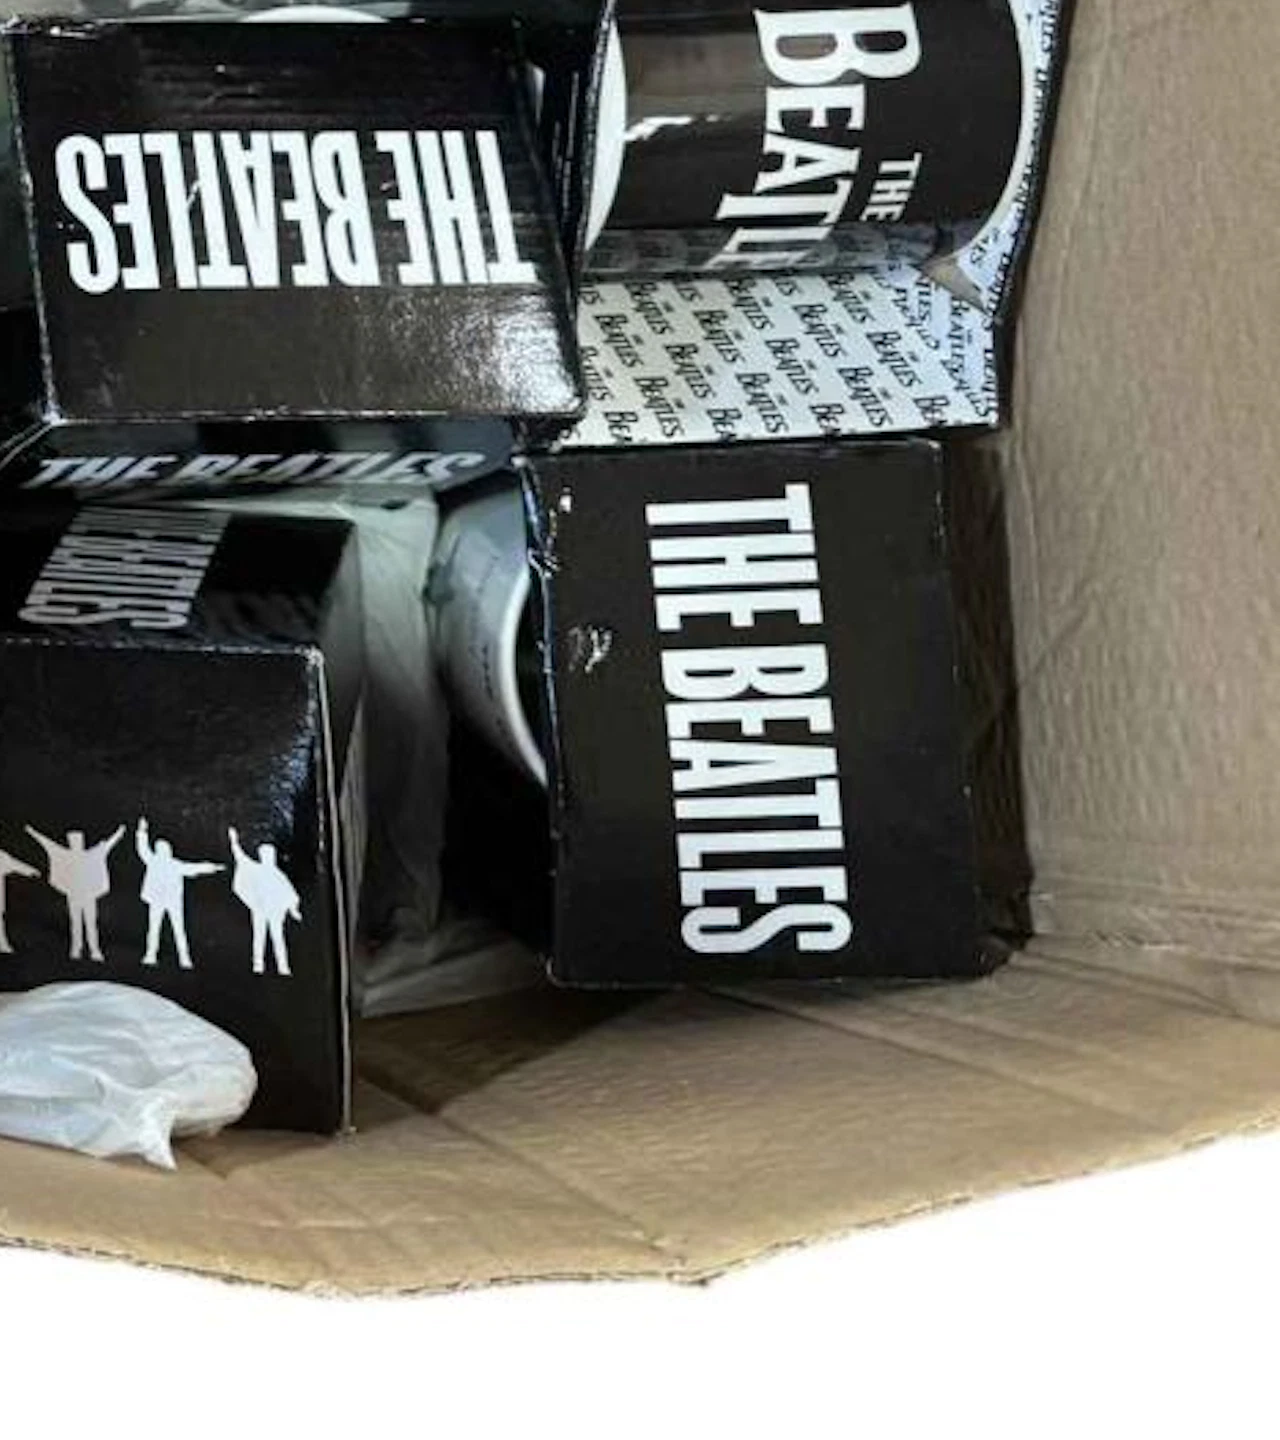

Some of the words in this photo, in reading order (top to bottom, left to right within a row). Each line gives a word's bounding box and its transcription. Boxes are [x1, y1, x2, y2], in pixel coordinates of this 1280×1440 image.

[54, 131, 382, 294] BEATLES
[376, 130, 545, 286] THE
[860, 152, 922, 222] THE
[16, 530, 219, 631] BEATLES
[643, 482, 826, 633] THE
[658, 642, 854, 955] BEATLES
